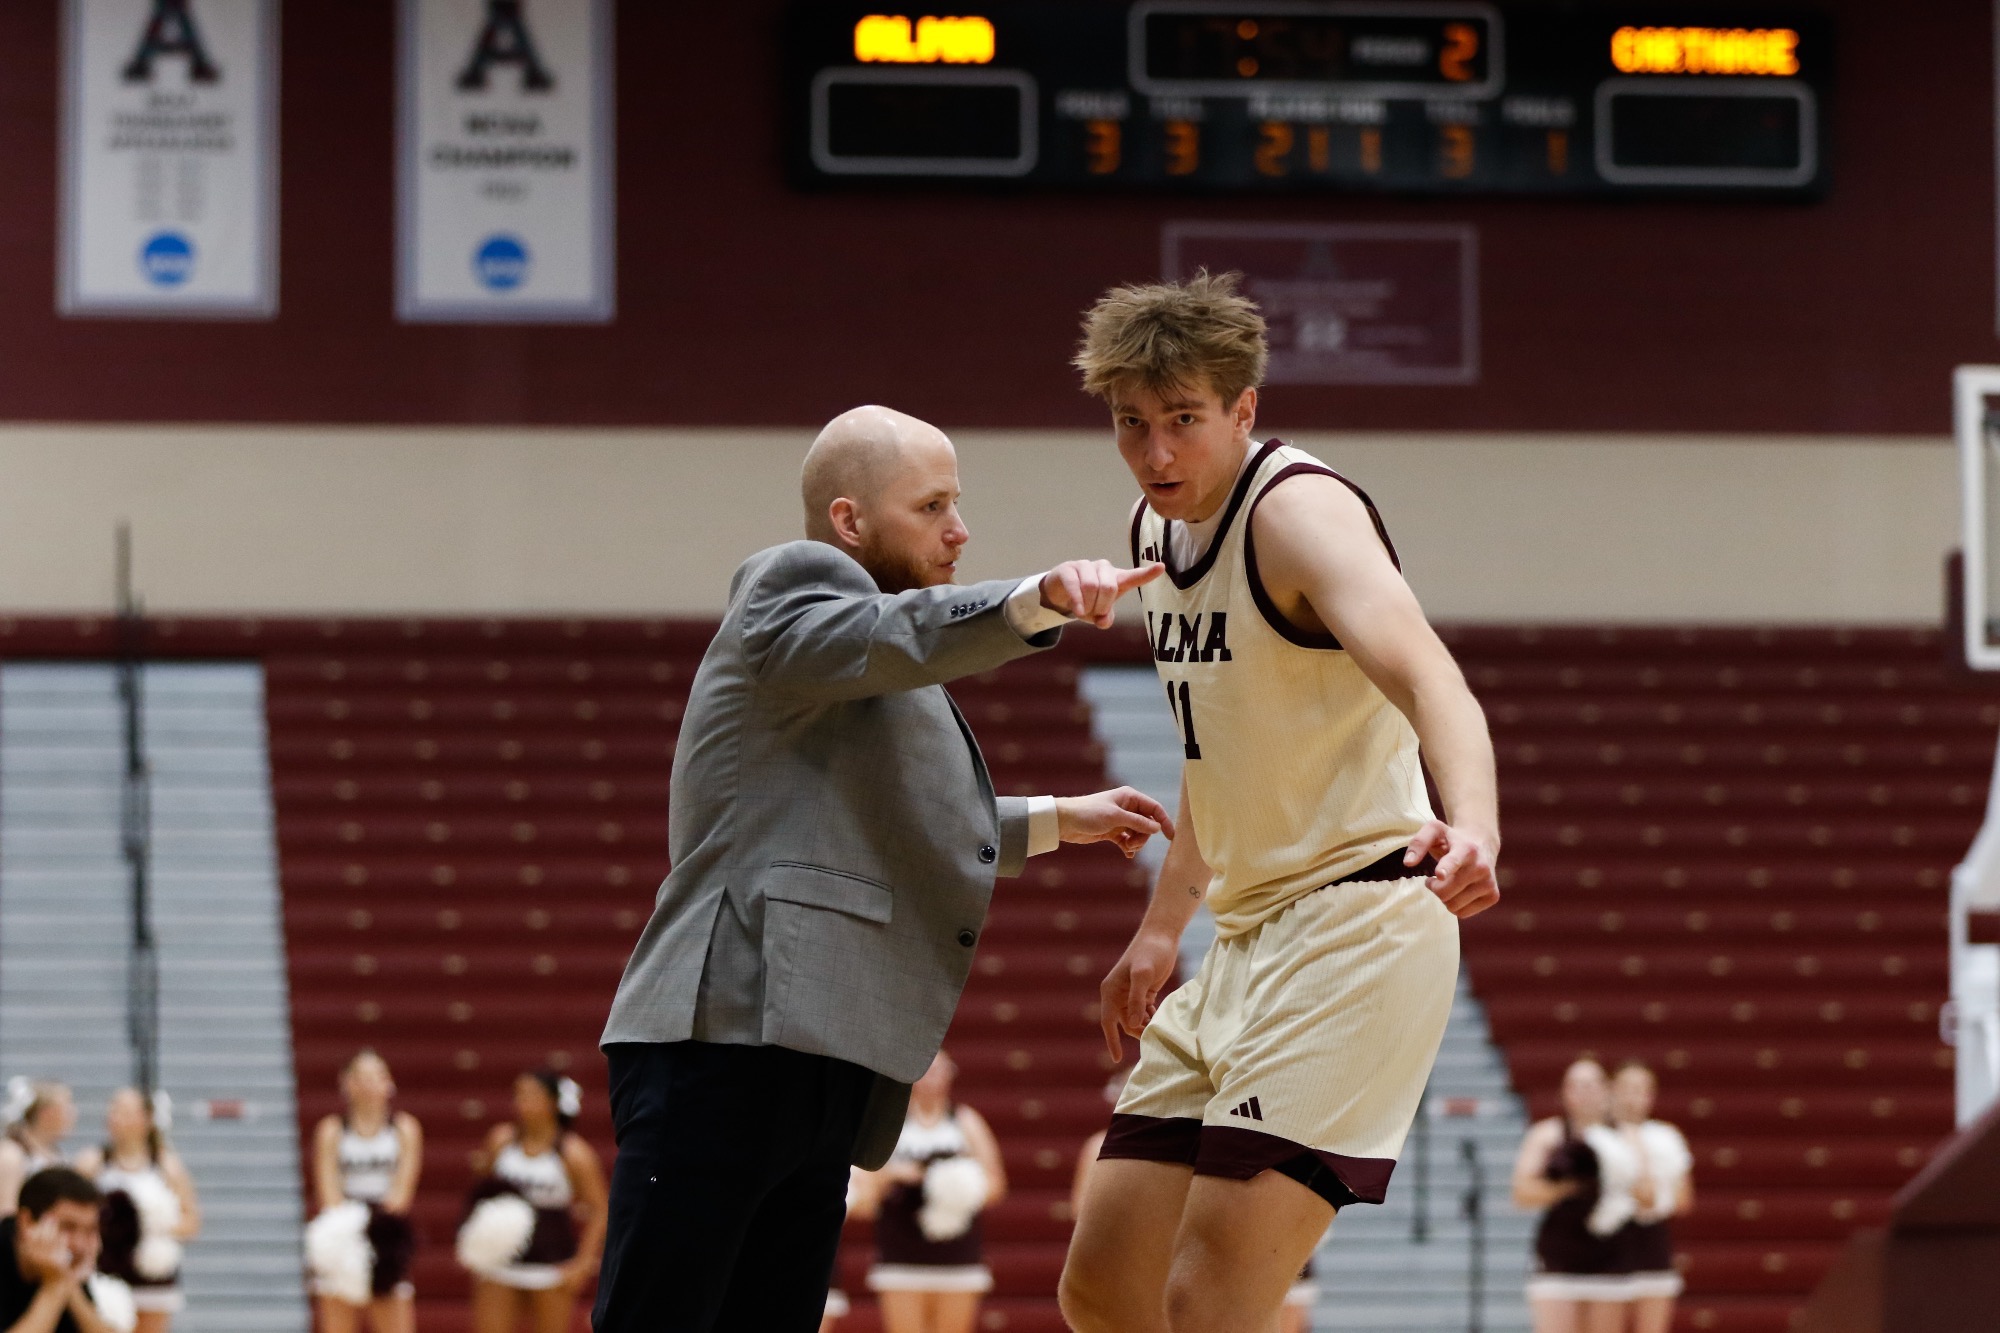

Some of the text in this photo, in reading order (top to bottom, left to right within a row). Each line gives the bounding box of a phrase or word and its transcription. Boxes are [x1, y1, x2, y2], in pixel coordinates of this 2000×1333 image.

[122, 0, 222, 83] A
[456, 0, 556, 90] A
[1437, 20, 1481, 81] 2
[1085, 119, 1122, 175] 3
[1164, 119, 1200, 176] 3
[1440, 123, 1476, 179] 3
[1547, 129, 1568, 175] 1
